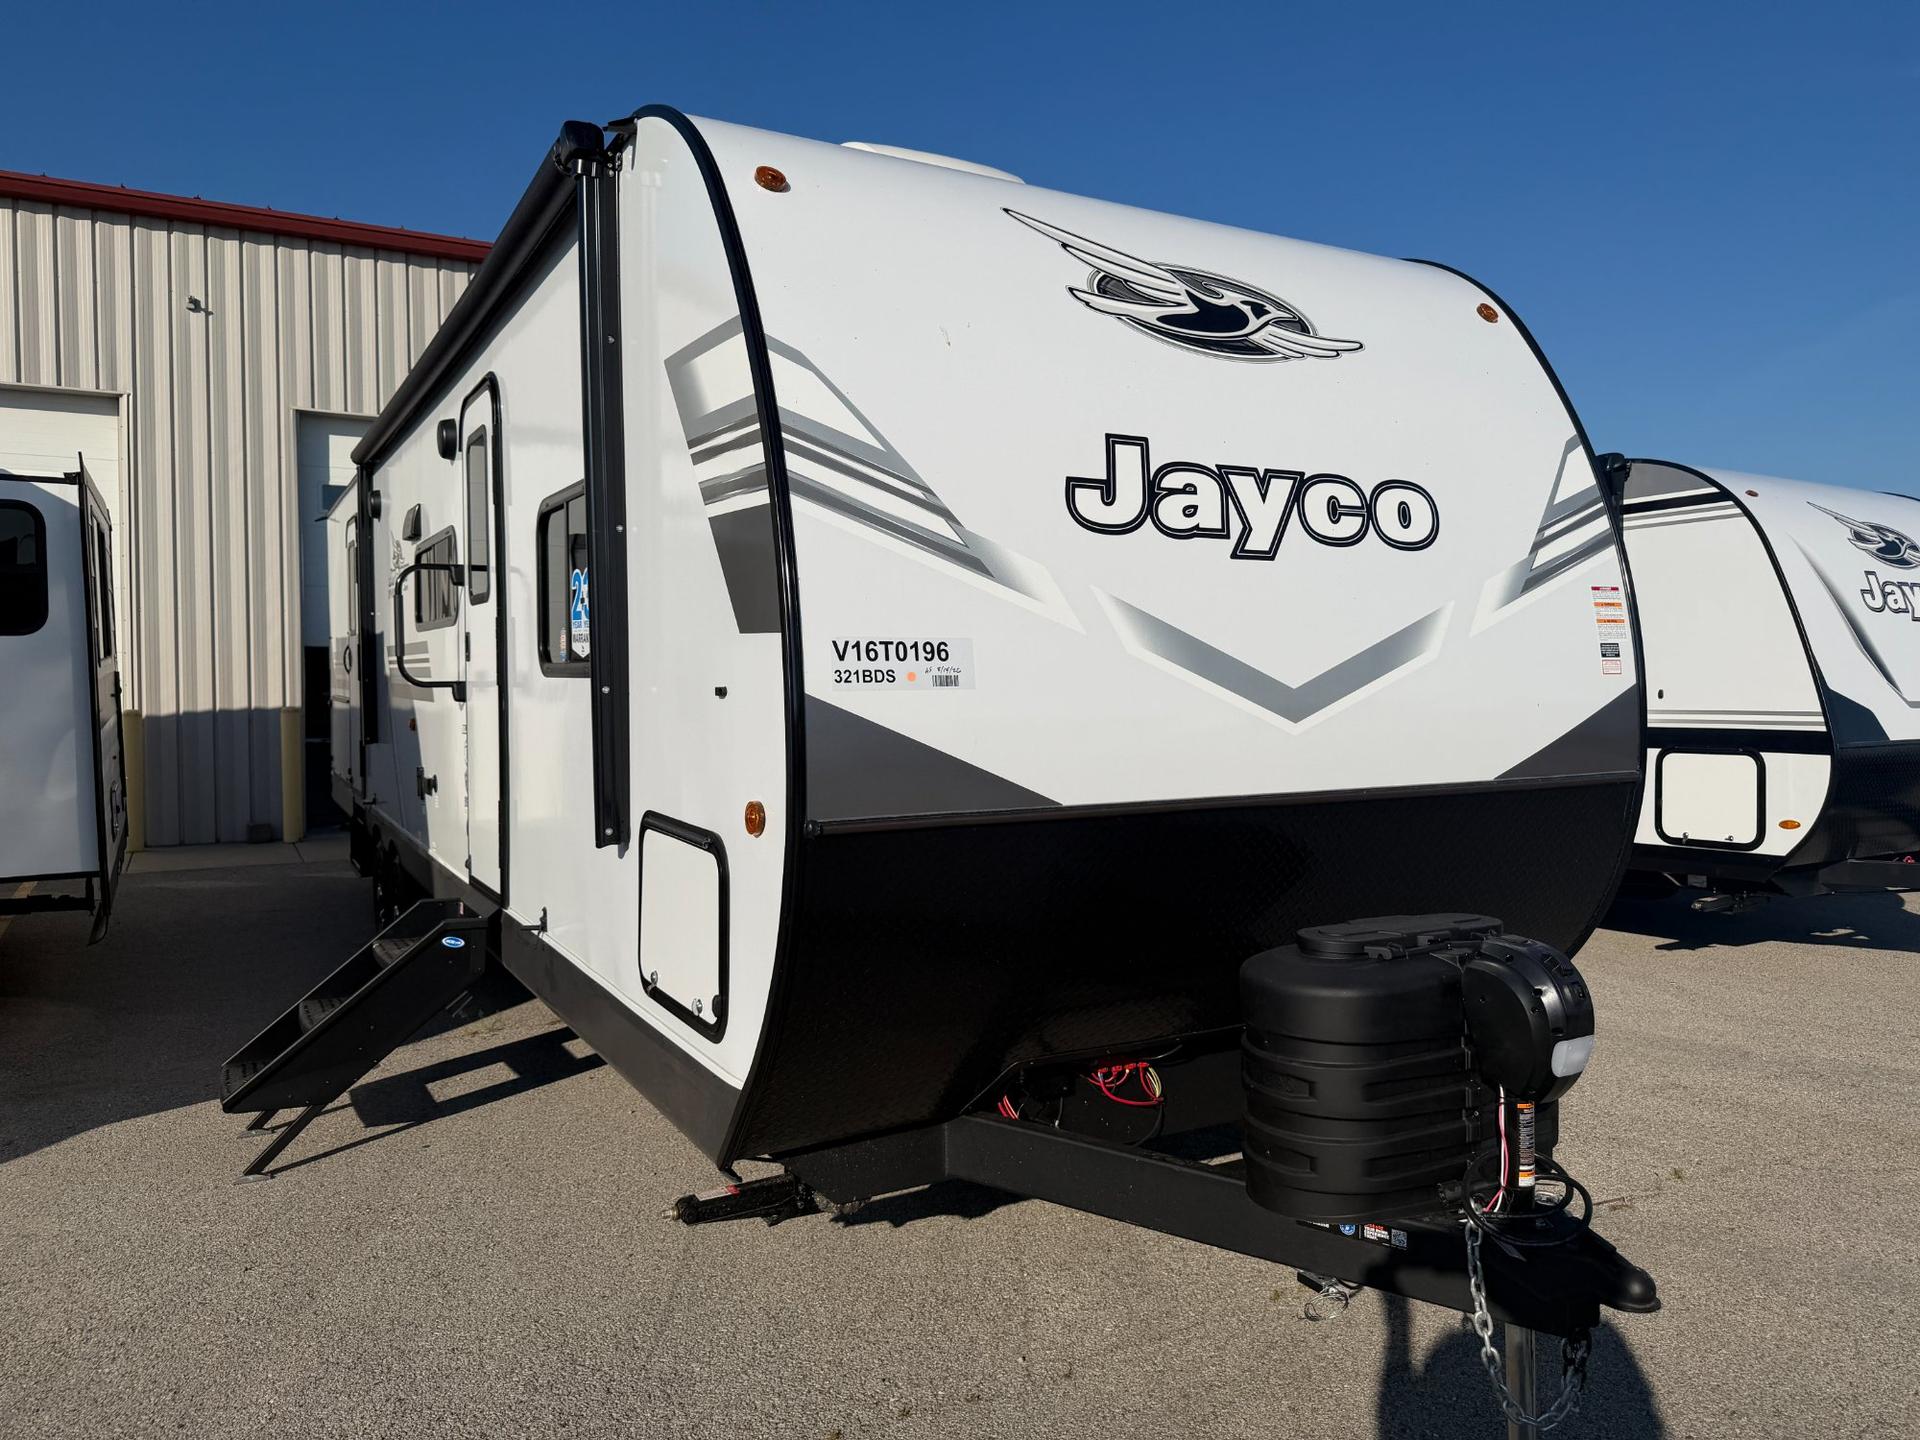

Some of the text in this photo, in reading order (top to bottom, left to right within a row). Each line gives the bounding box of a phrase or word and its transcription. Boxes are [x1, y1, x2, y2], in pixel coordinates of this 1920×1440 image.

[1065, 433, 1440, 561] Jayco
[1861, 571, 1920, 621] Jay
[831, 640, 950, 662] V16T0196
[834, 669, 897, 684] 321BDS
